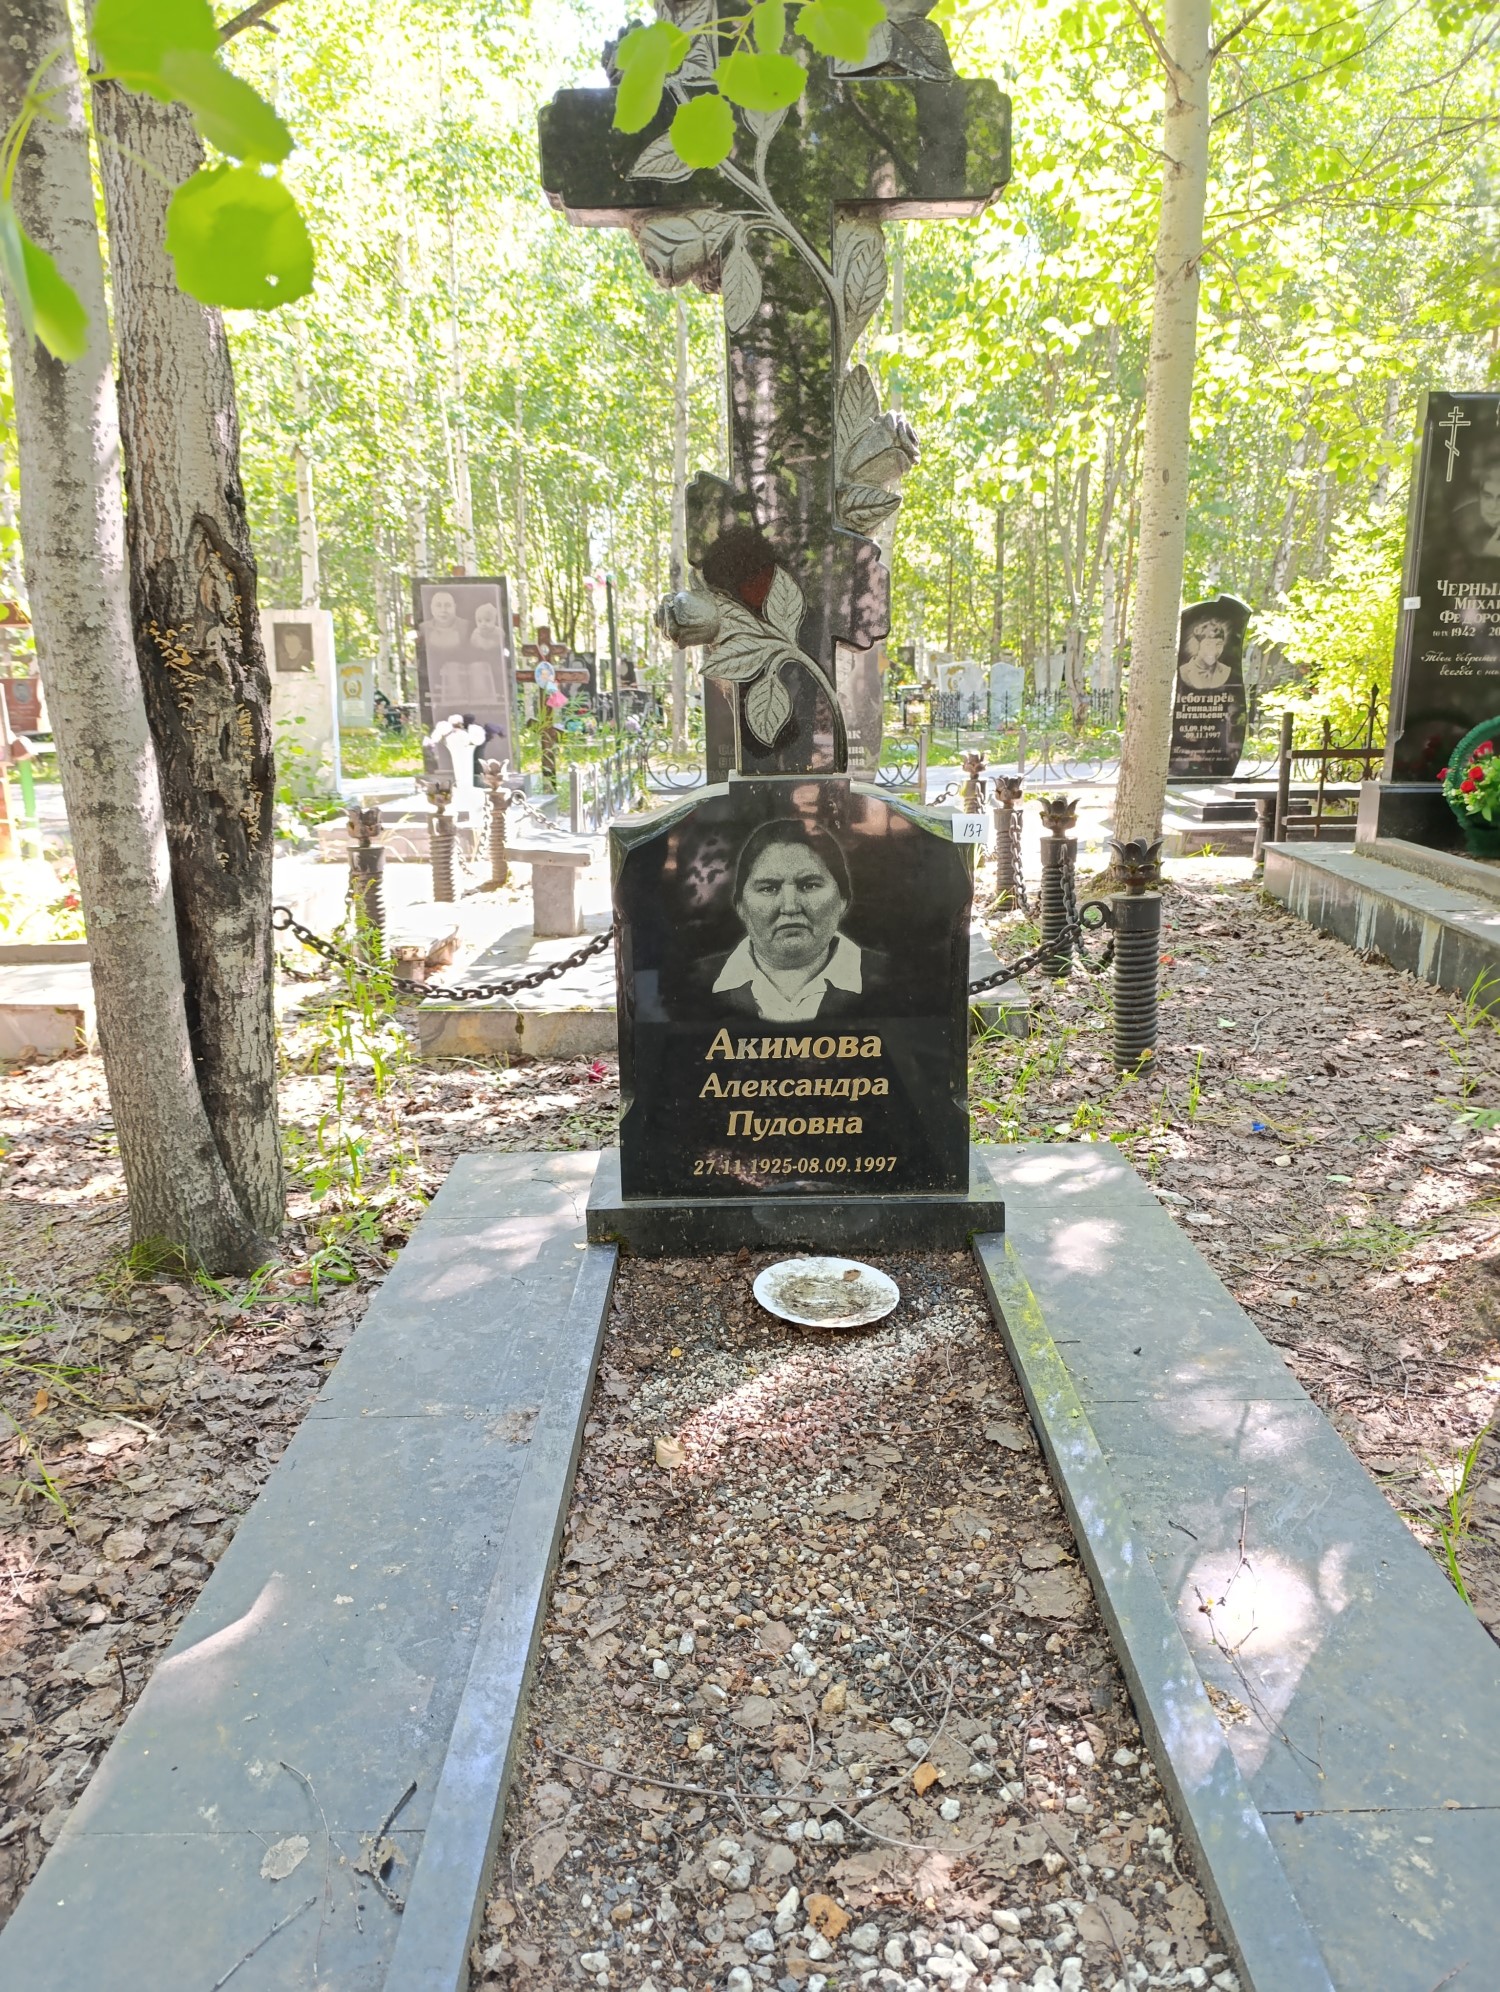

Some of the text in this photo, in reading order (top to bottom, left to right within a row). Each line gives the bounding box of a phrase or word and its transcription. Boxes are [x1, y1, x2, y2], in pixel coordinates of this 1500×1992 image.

[1436, 580, 1500, 597] ЧЕРНЫ
[1451, 625, 1476, 637] 1942
[1175, 711, 1229, 719] Витальевич
[1182, 704, 1224, 712] Геннадий
[963, 823, 983, 838] 137
[705, 1027, 882, 1060] Акимова
[699, 1072, 889, 1101] Александра
[726, 1110, 863, 1141] Пудовна
